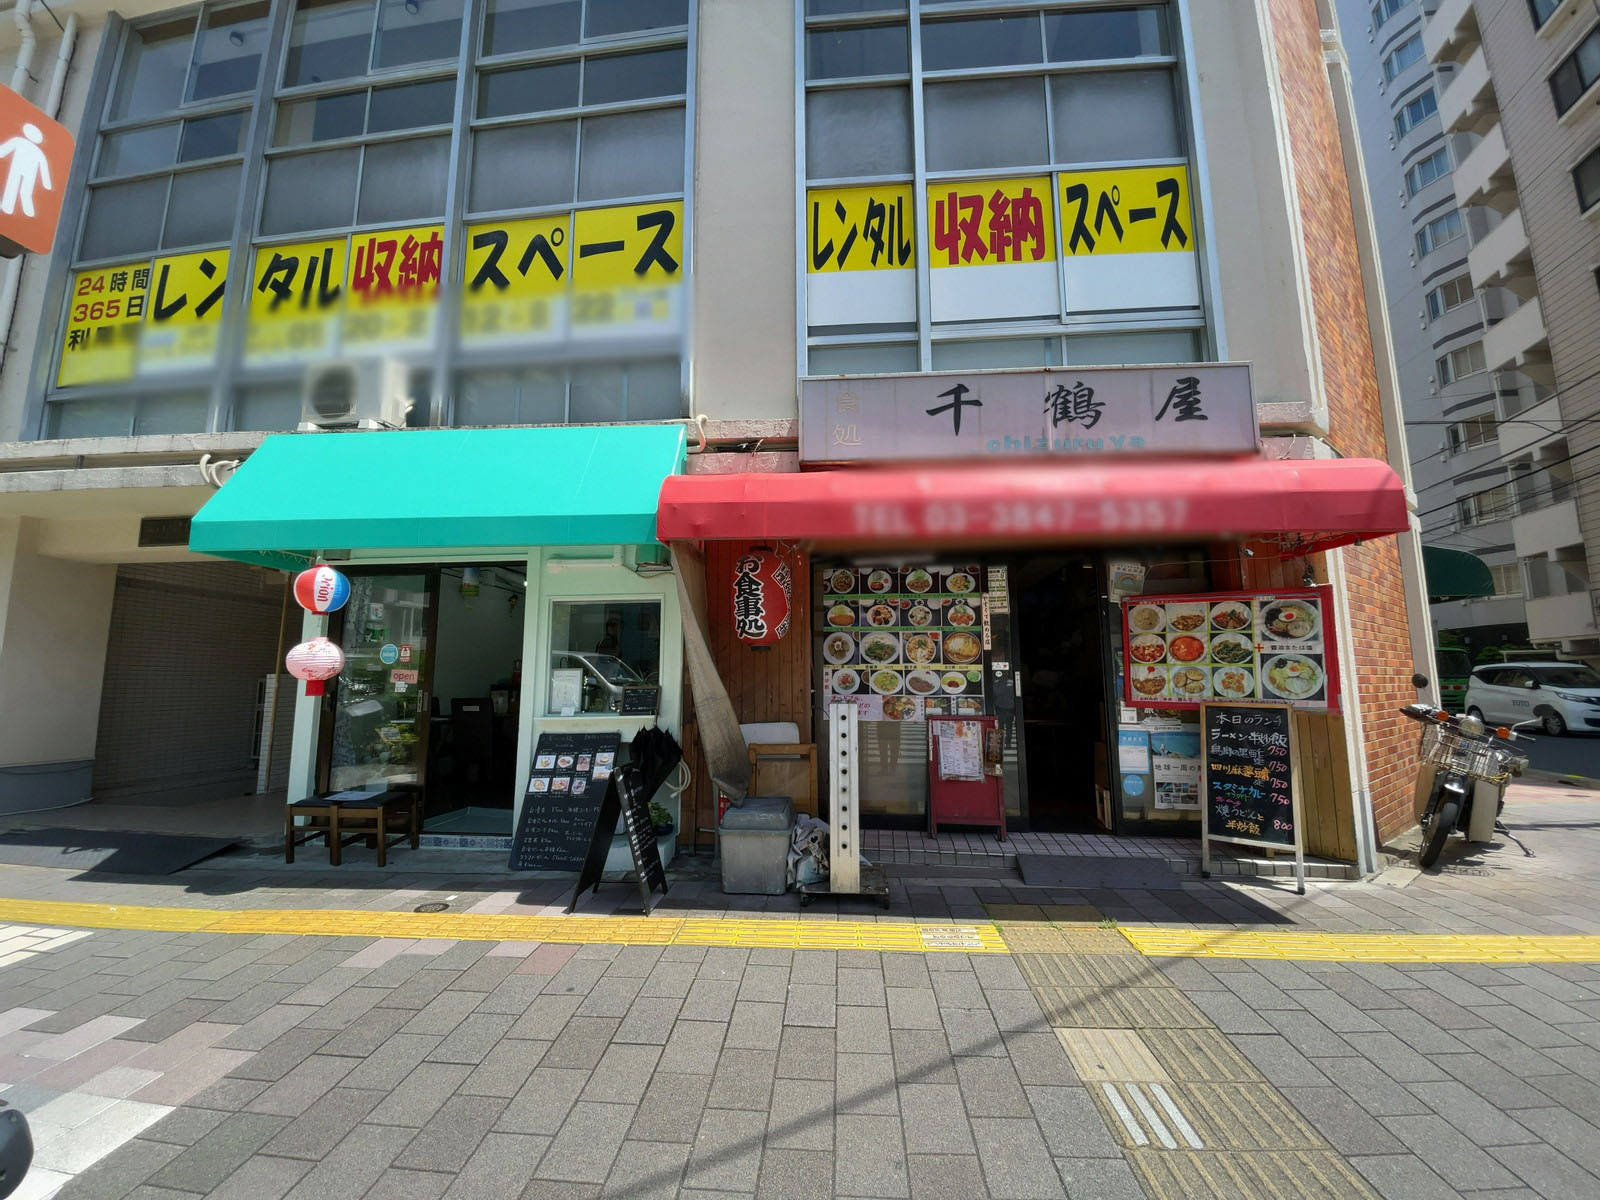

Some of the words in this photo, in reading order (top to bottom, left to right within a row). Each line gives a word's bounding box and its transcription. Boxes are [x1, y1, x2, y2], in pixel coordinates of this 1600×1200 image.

[77, 268, 150, 296] 24時間
[73, 296, 144, 322] 365日
[926, 376, 1208, 436] 千鶴屋
[393, 672, 415, 681] open
[1216, 712, 1282, 726] 本日のランチ
[1267, 745, 1287, 756] 750
[1268, 761, 1288, 772] 750
[1269, 777, 1288, 789] 750
[1270, 793, 1290, 805] 750
[1273, 820, 1293, 831] 800
